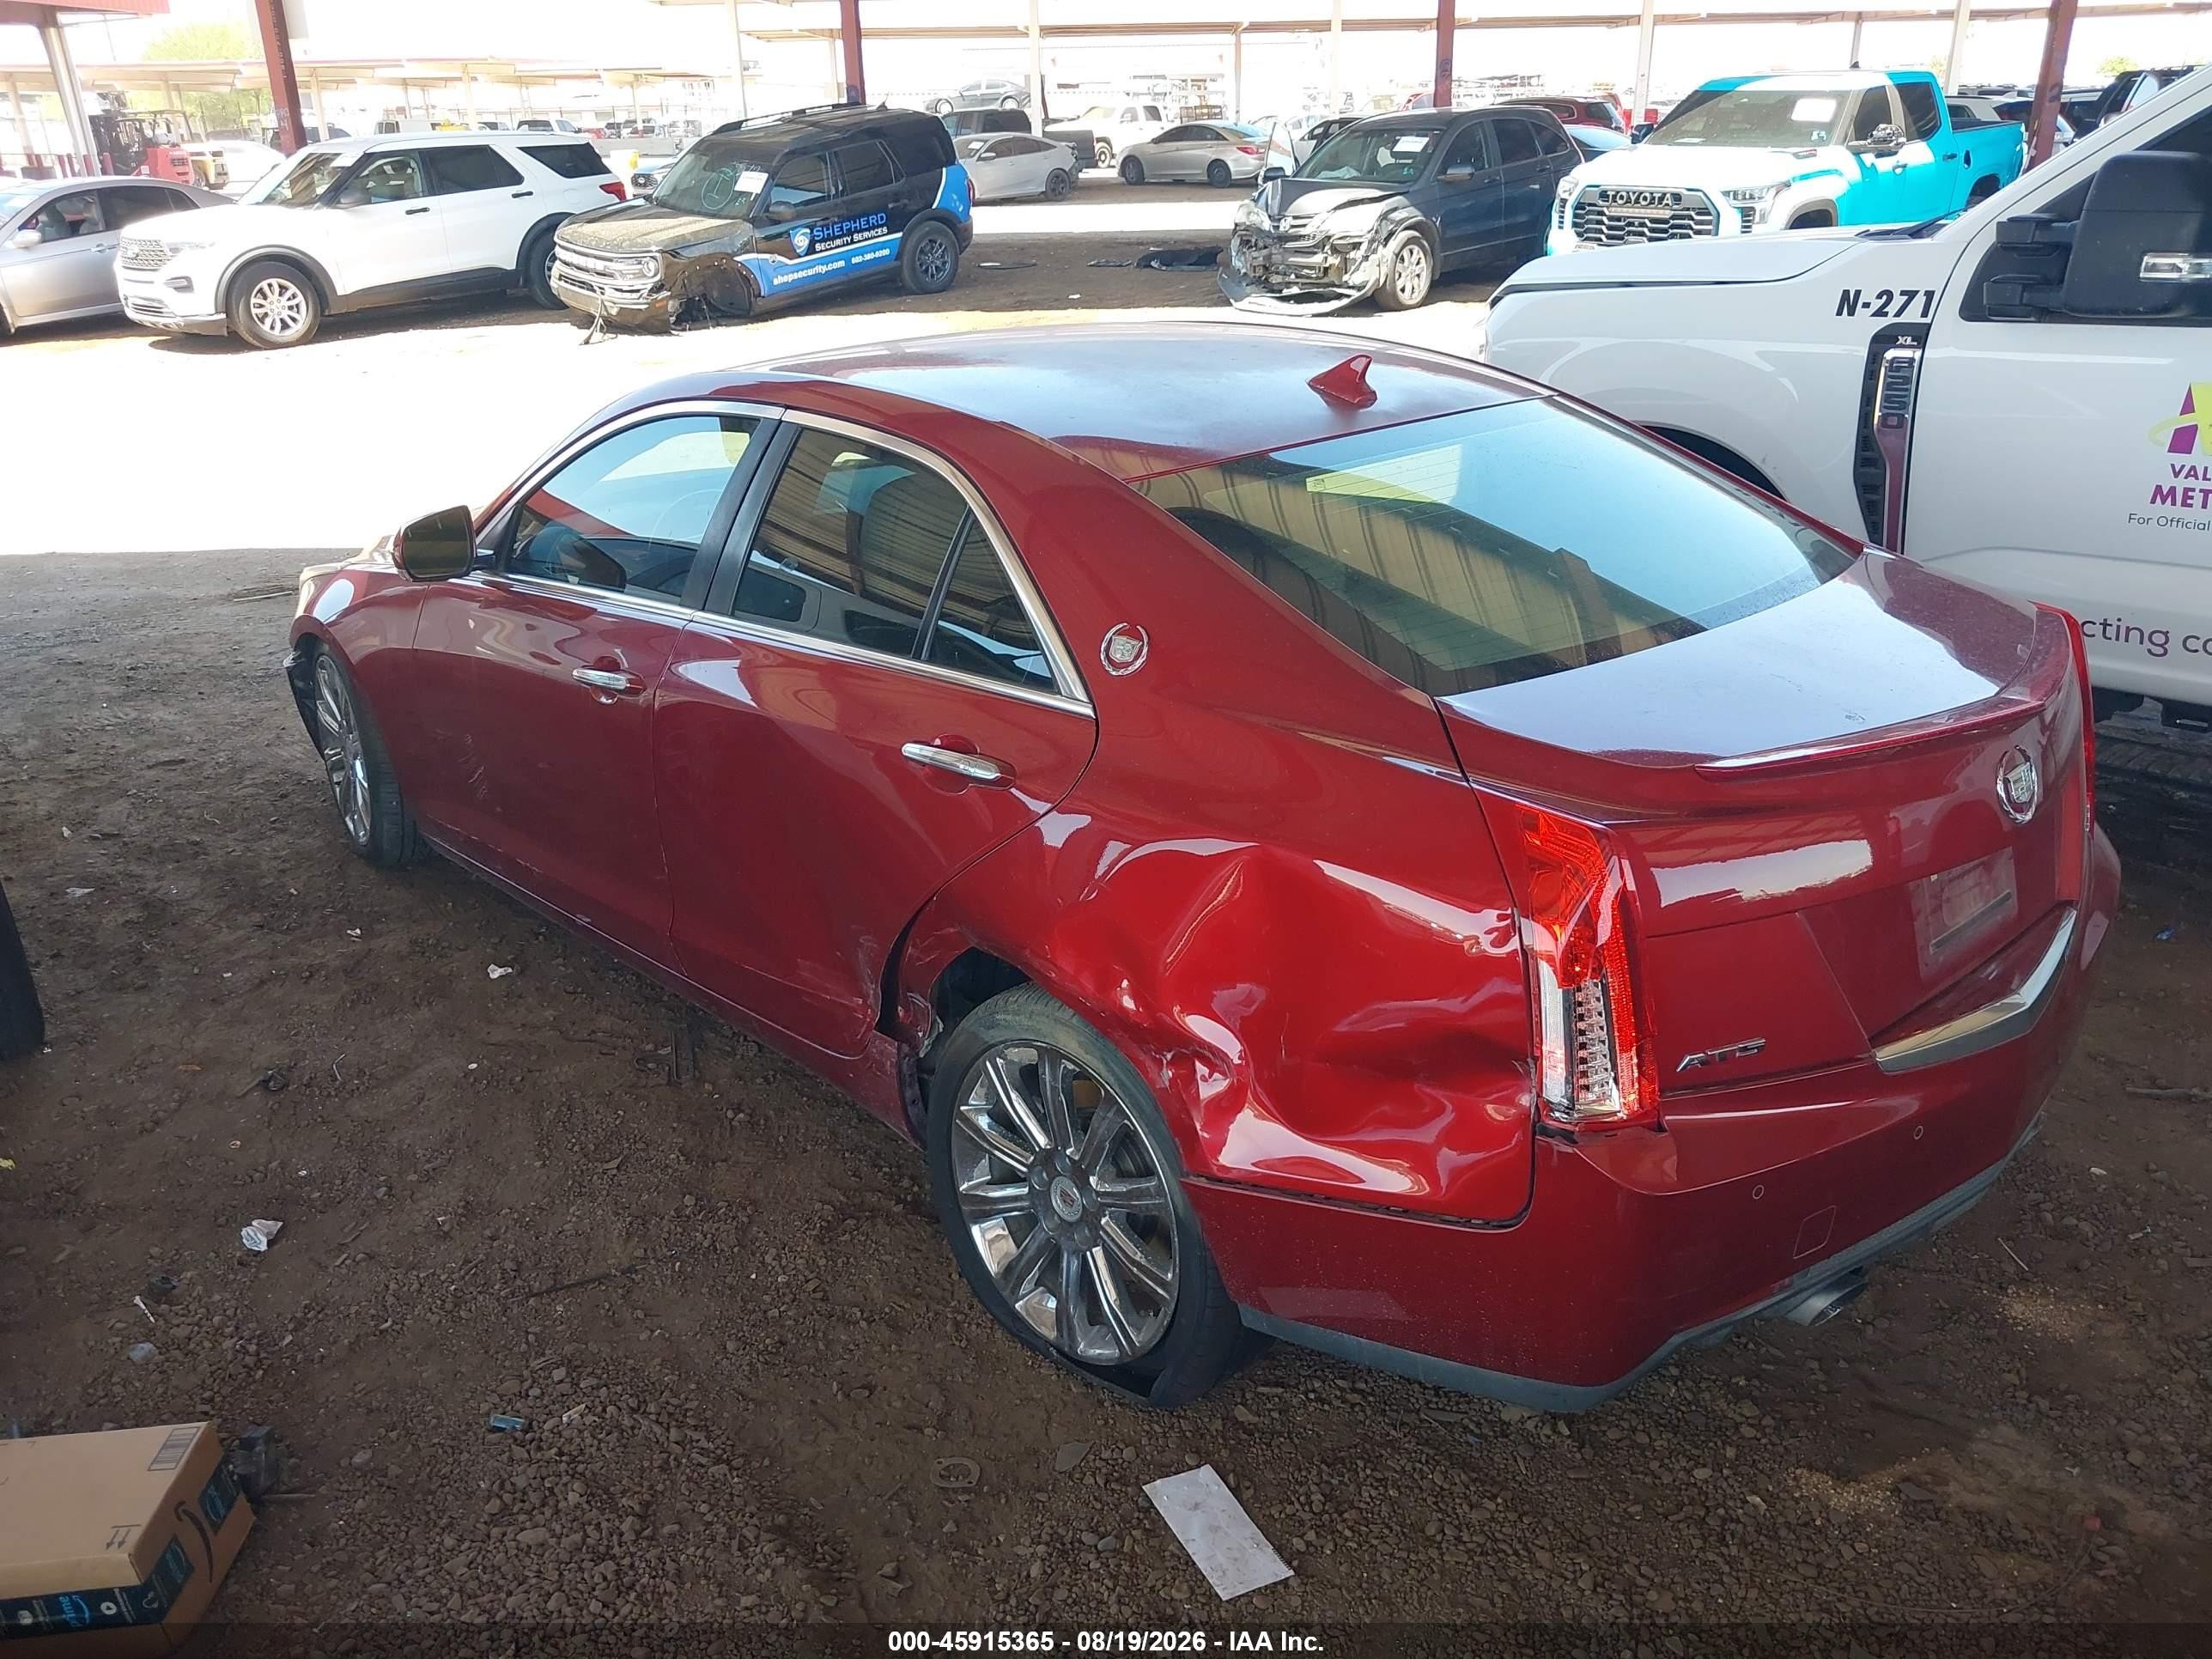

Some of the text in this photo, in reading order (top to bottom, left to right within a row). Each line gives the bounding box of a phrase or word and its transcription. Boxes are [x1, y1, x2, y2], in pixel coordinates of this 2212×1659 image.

[1607, 191, 1674, 207] TOYOTA
[813, 212, 886, 240] SHEPHERD
[815, 227, 888, 252] SECURITY SERVICES
[1835, 289, 1936, 319] N-271
[1895, 336, 1917, 345] XL
[2170, 463, 2212, 482] VAL
[2149, 483, 2212, 510] MET
[2127, 513, 2211, 532] For Official
[2080, 617, 2170, 658] cting
[1675, 1036, 1766, 1073] ATS
